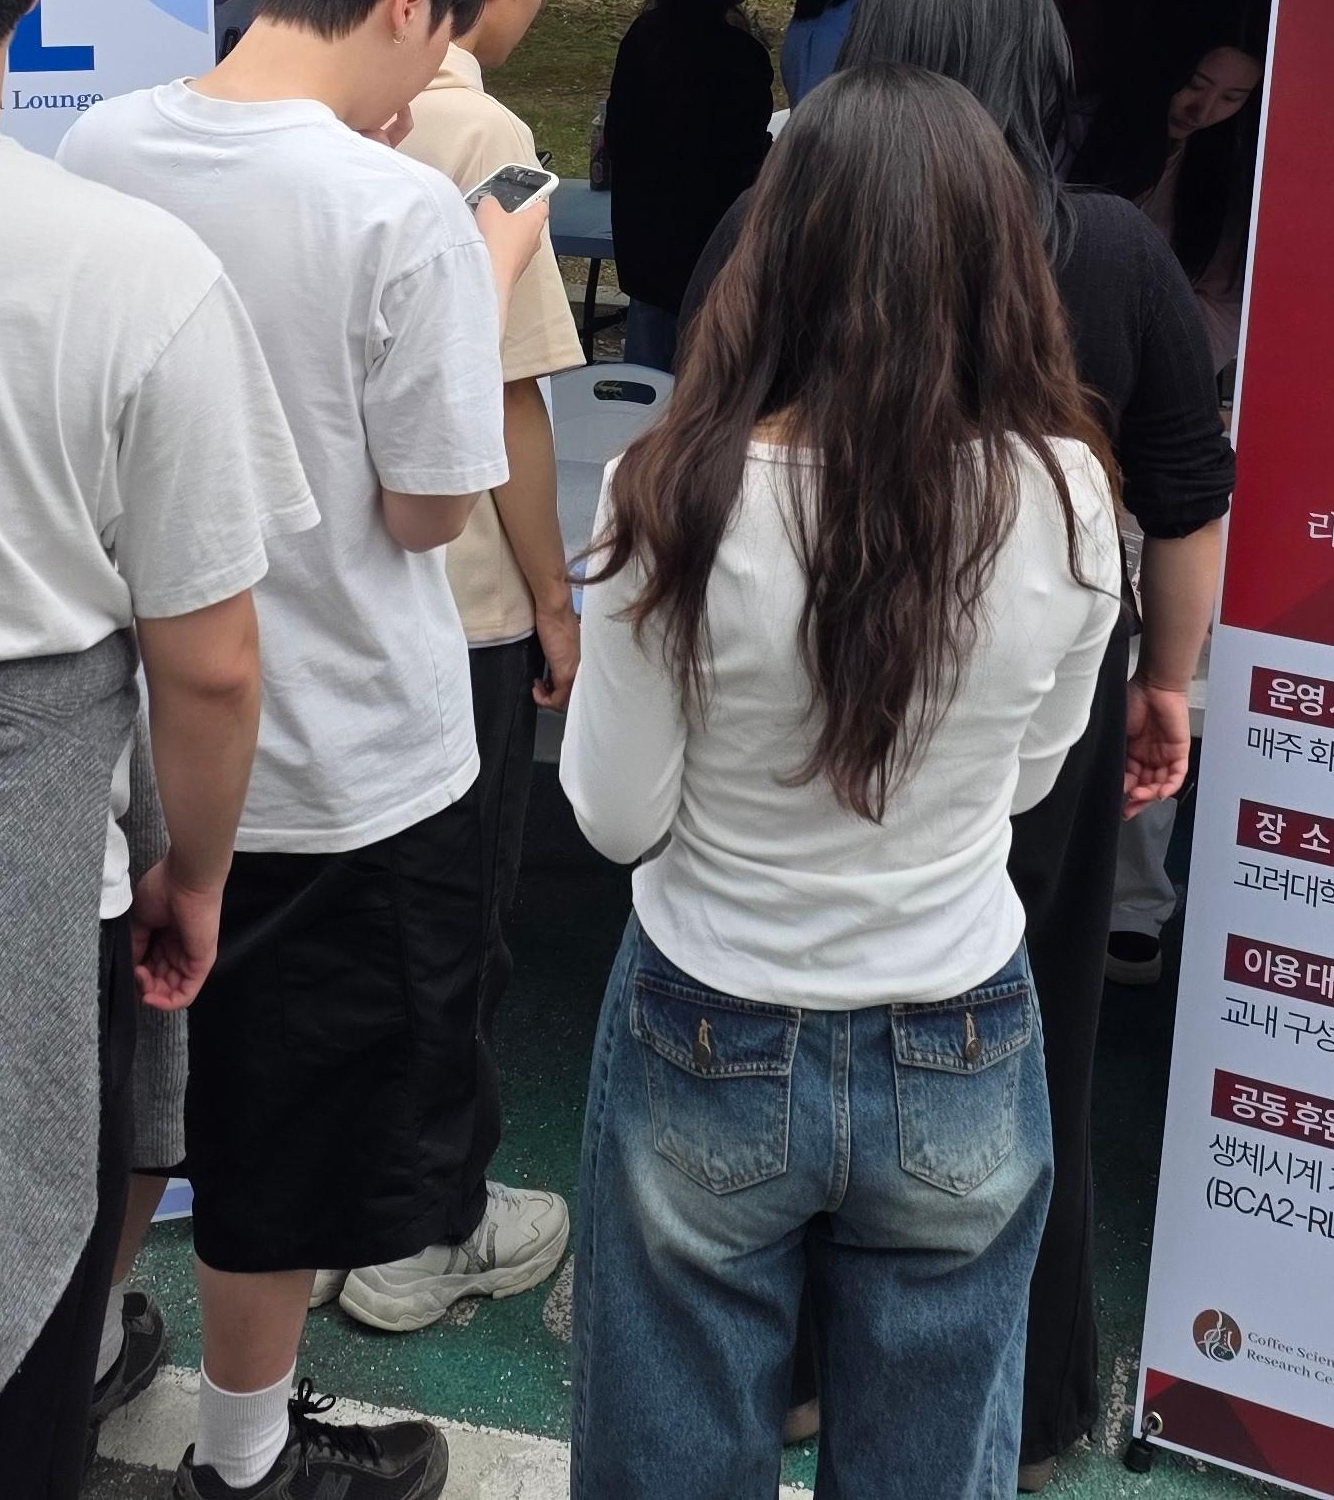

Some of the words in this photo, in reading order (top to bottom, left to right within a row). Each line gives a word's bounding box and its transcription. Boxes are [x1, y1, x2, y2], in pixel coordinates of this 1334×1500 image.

[1268, 678, 1324, 718] 운영
[1247, 725, 1303, 764] 매주
[1243, 947, 1302, 990] 이용
[1221, 998, 1277, 1040] 교내
[1229, 1084, 1288, 1126] 공동
[1208, 1132, 1322, 1194] 생체시계
[1247, 1348, 1310, 1378] Research
[1248, 1331, 1293, 1354] Coffee
